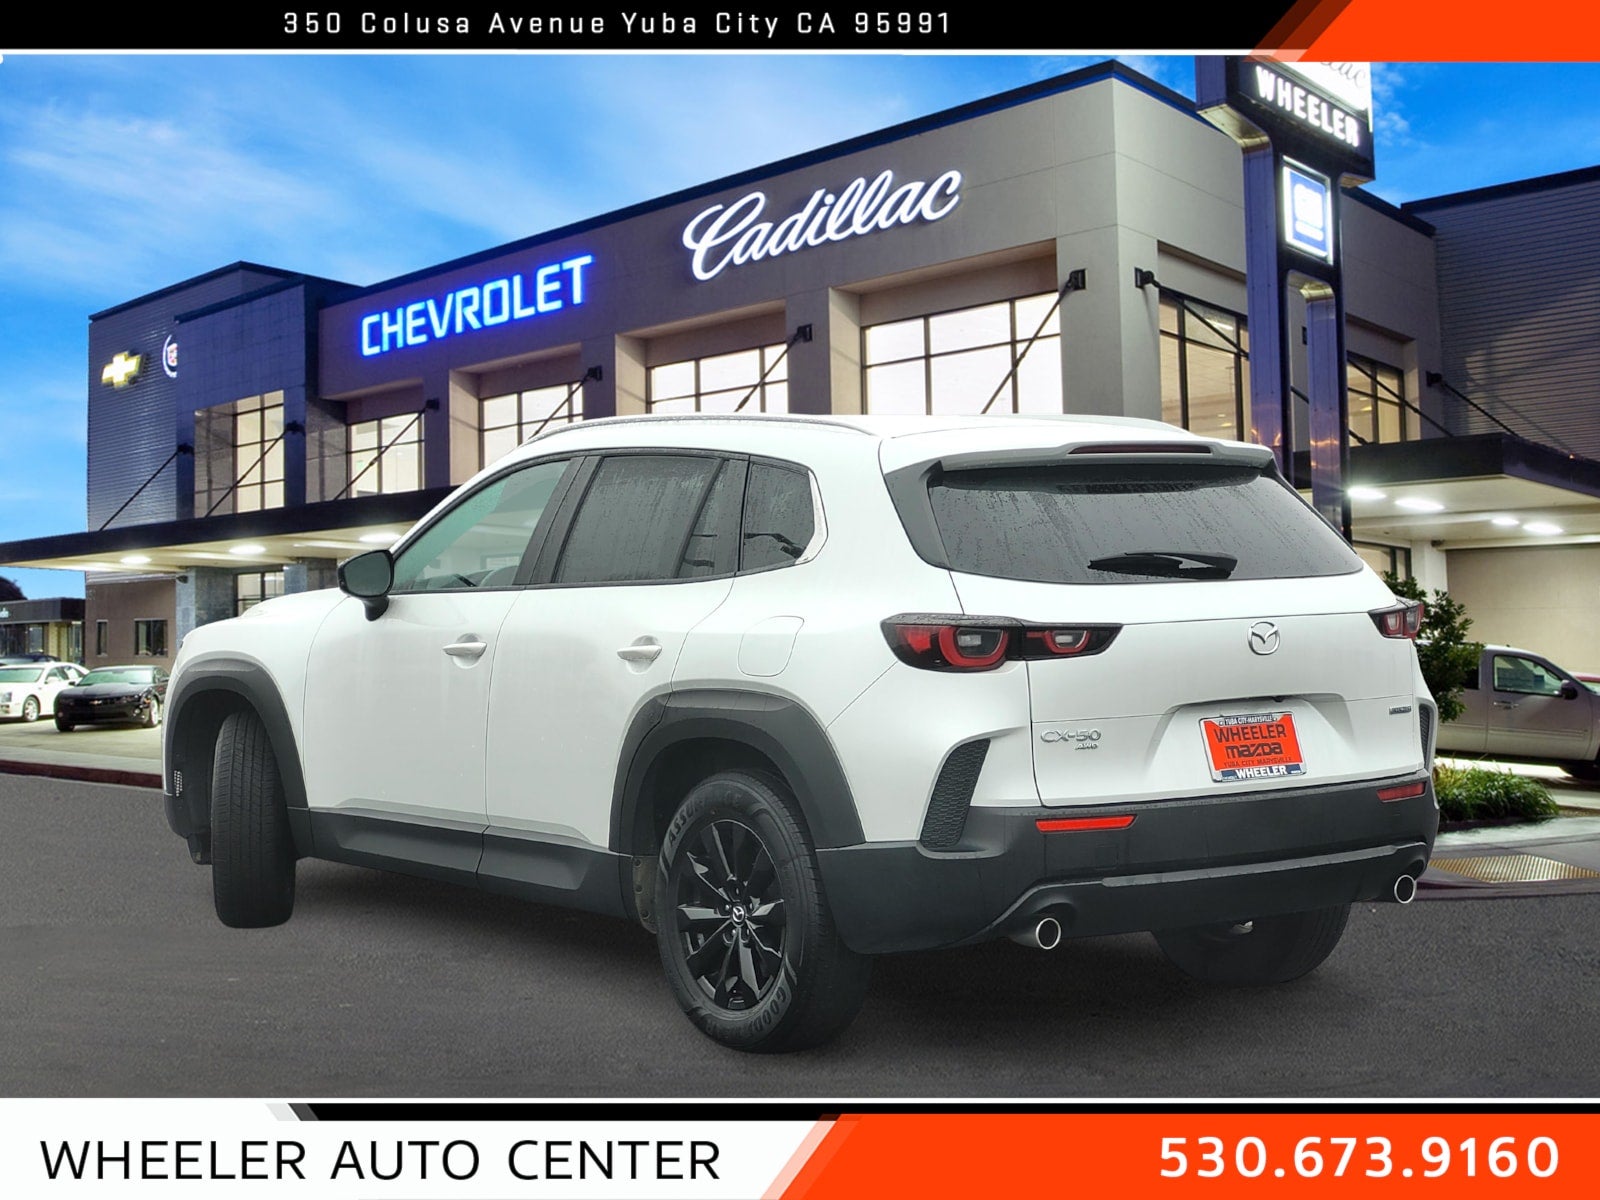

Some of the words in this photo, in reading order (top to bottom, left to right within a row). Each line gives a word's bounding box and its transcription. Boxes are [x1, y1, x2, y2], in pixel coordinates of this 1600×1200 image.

[1255, 65, 1360, 147] WHEELER
[682, 169, 962, 281] Cadillac
[361, 255, 593, 357] CHEVROLET
[1040, 729, 1102, 743] CX-50
[1214, 724, 1287, 743] WHEELER
[1235, 765, 1288, 779] WHEELER
